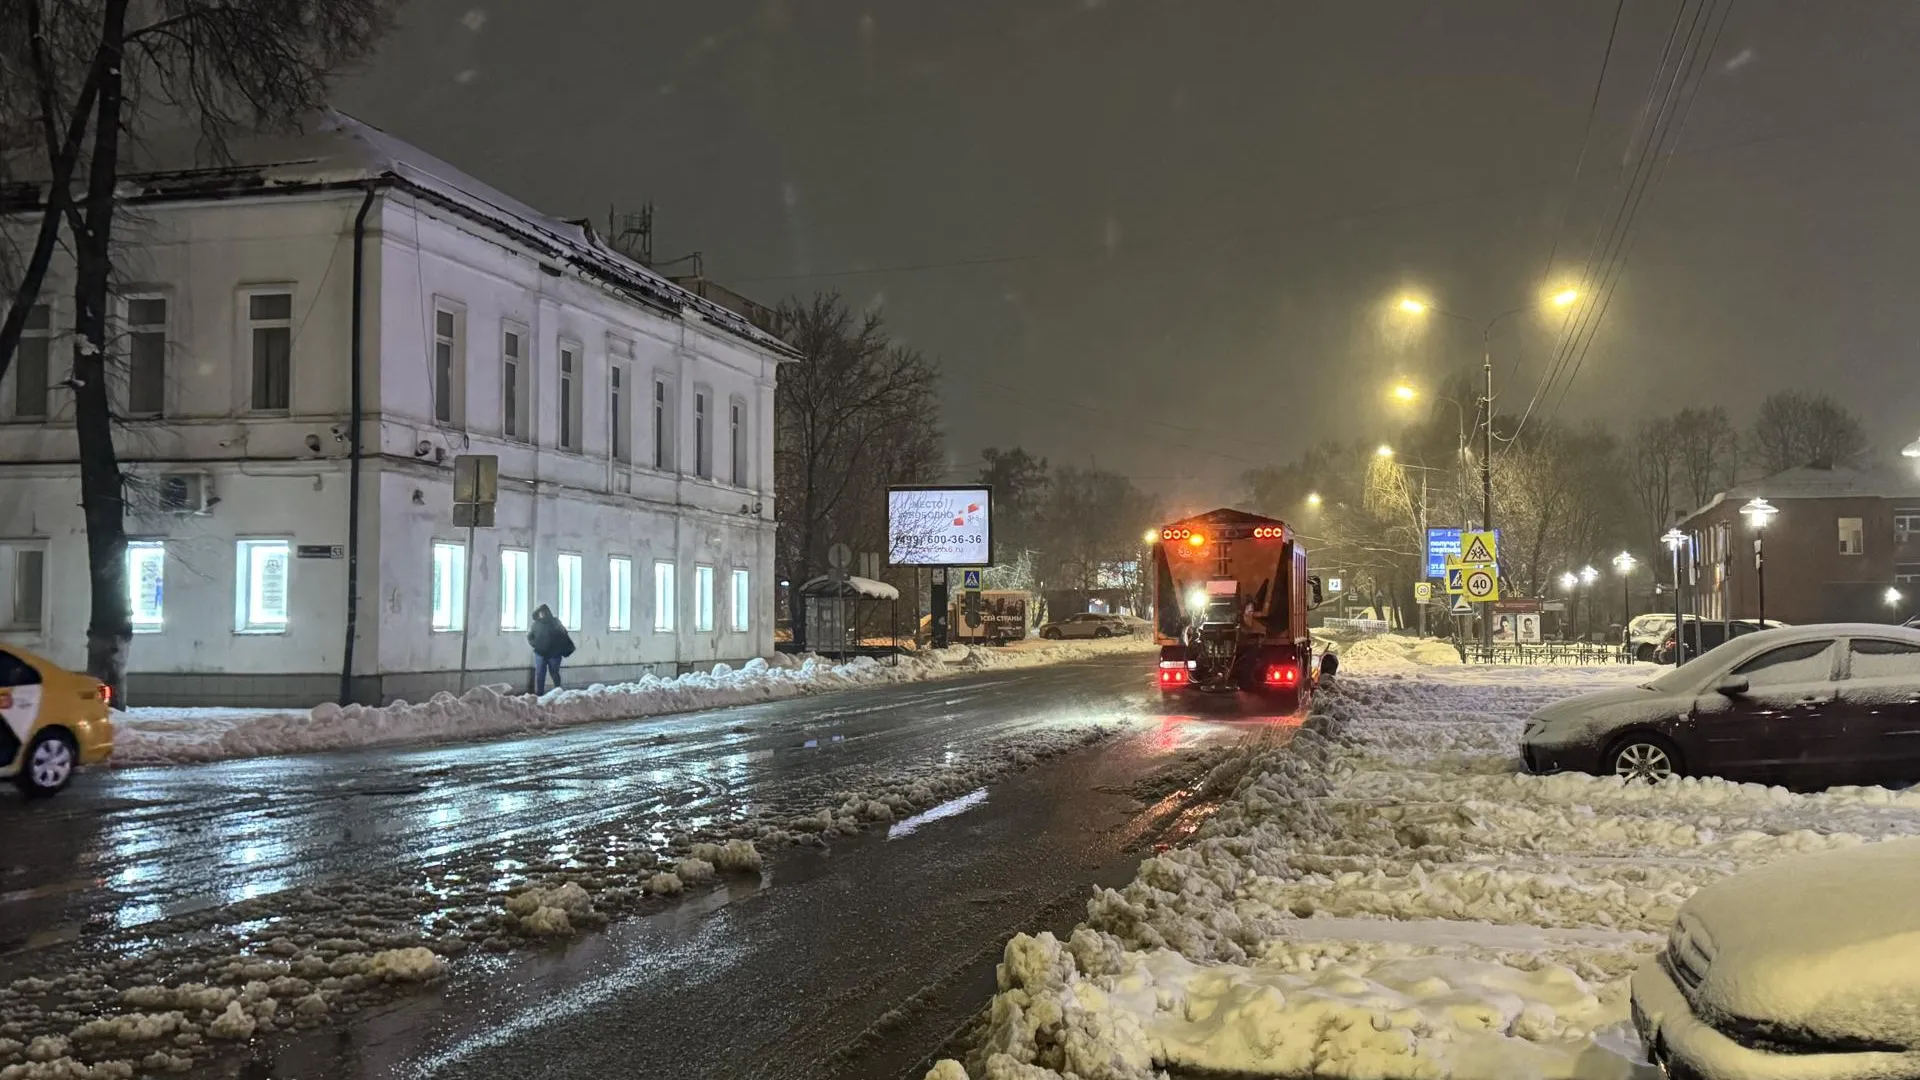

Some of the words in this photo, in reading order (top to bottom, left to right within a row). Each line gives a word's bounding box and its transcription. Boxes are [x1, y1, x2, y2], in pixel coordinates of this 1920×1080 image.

[927, 534, 982, 544] 600-36-36
[332, 547, 342, 558] 53
[1472, 579, 1487, 590] 40
